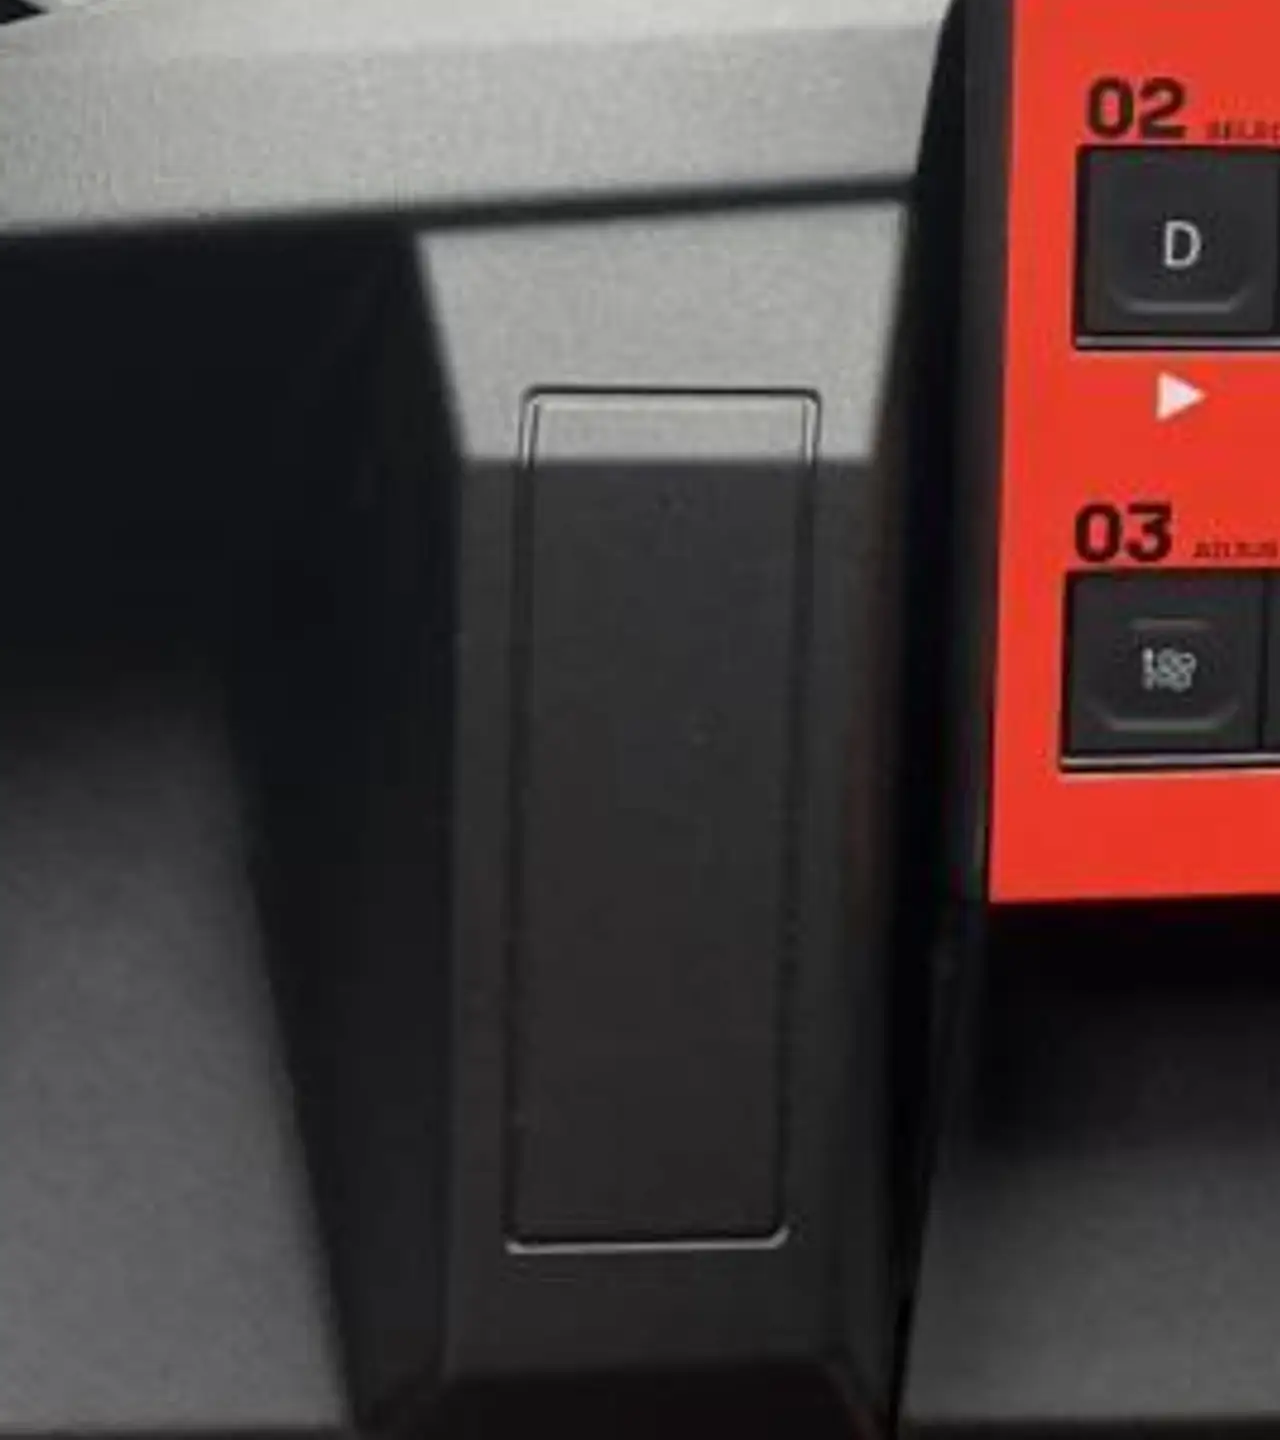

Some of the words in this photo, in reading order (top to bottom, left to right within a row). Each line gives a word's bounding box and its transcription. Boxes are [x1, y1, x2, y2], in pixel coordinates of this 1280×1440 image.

[1087, 77, 1186, 140] 02
[1163, 219, 1201, 271] D
[1075, 502, 1172, 563] 03
